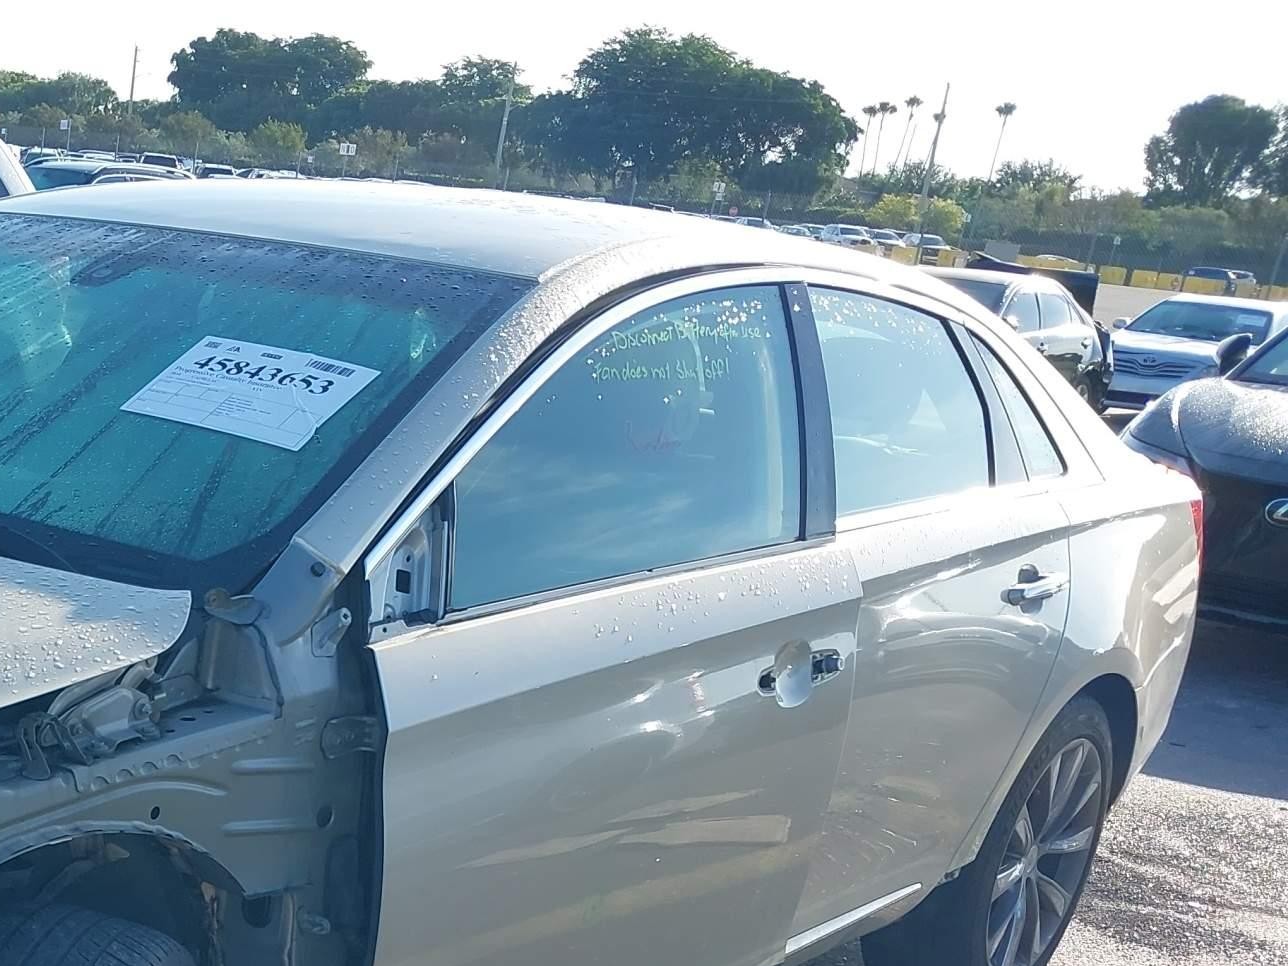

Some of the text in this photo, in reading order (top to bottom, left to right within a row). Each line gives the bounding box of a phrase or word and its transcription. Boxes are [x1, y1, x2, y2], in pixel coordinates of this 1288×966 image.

[673, 318, 718, 344] Bttery
[193, 355, 335, 395] 45843653
[651, 362, 670, 380] not
